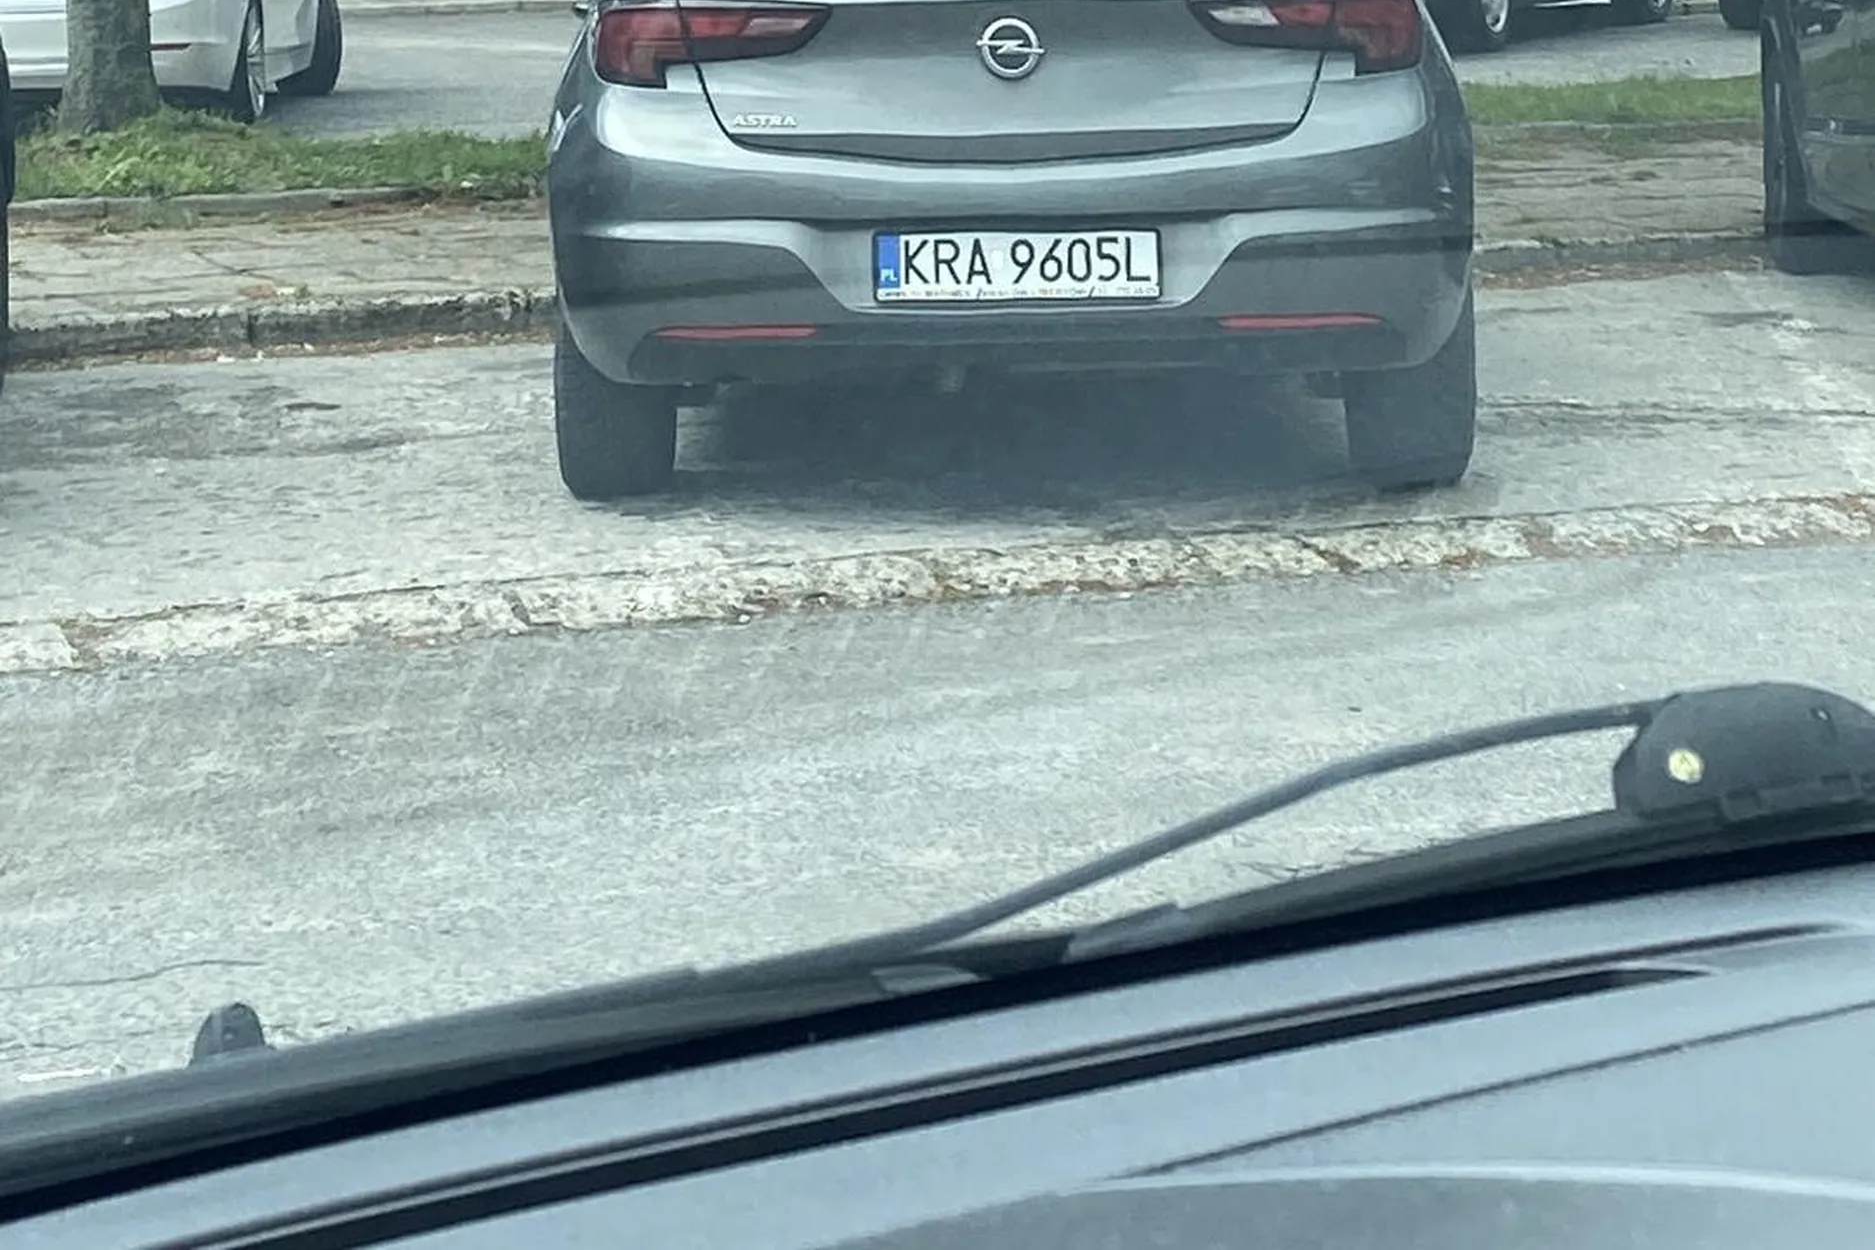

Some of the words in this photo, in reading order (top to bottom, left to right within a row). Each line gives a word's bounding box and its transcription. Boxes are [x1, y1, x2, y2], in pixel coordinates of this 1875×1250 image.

[733, 113, 797, 127] ASTRA
[903, 238, 992, 285] KRA
[1010, 236, 1152, 285] 9605L
[880, 268, 898, 283] PL
